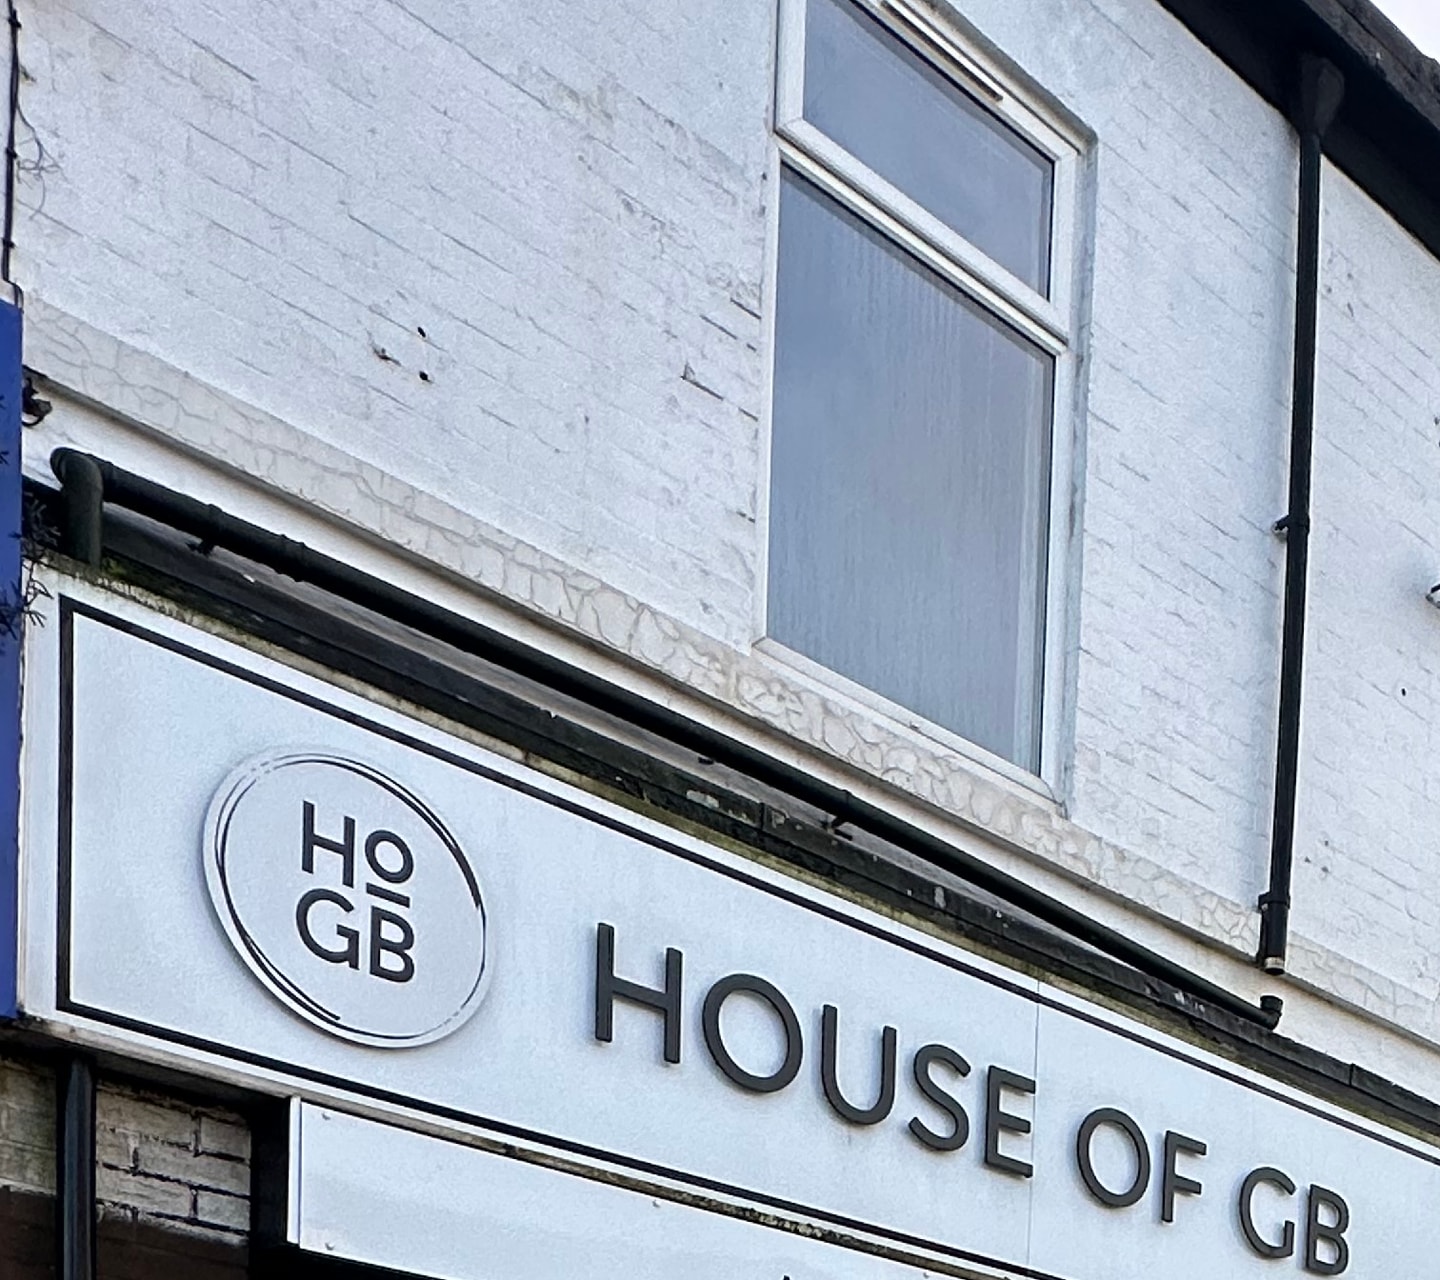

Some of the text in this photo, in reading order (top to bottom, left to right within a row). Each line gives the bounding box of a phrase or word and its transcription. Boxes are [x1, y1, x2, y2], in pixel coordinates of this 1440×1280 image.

[592, 921, 1350, 1278] HOUSE OF GB
